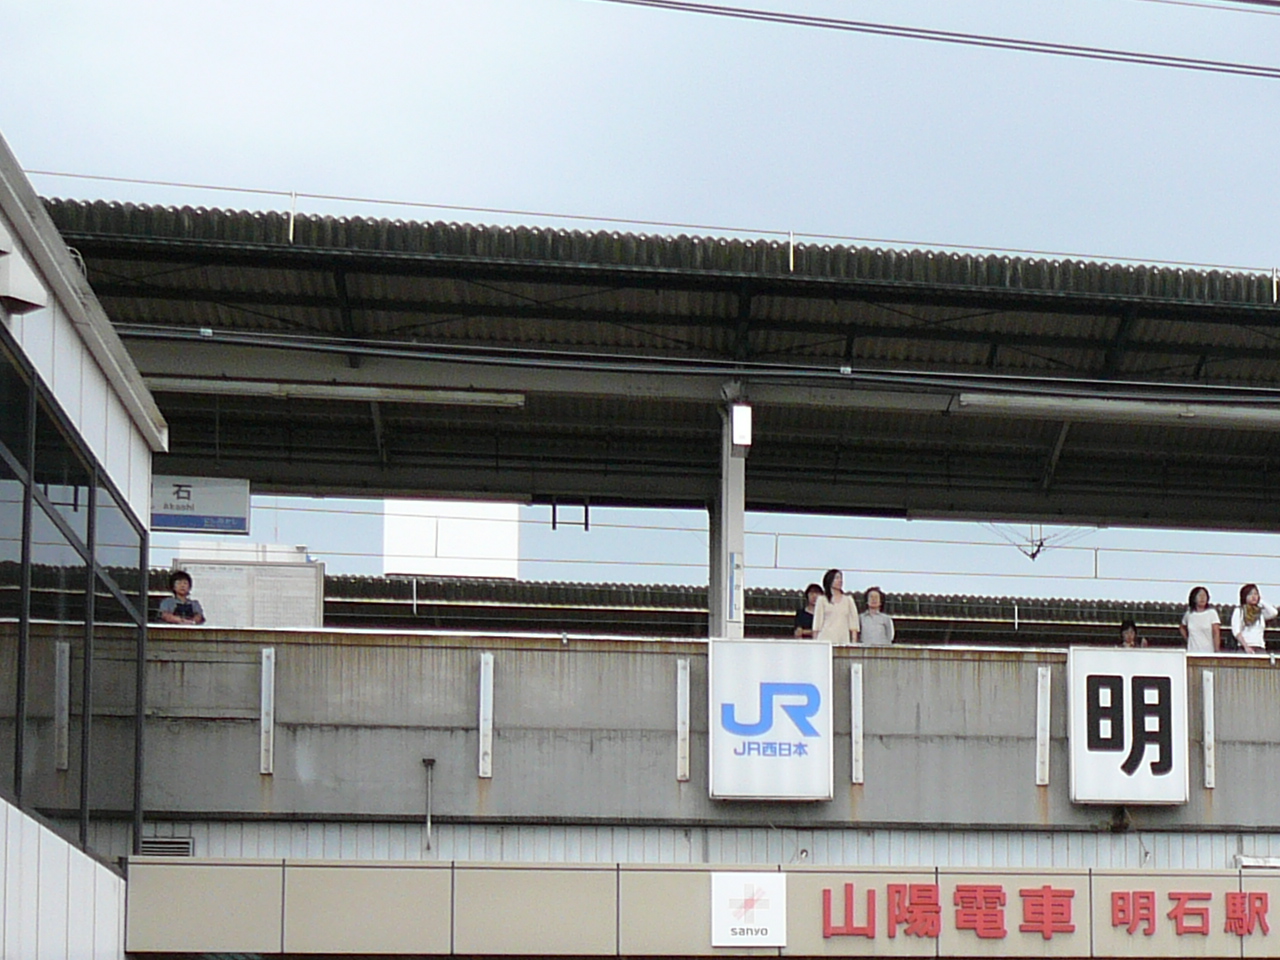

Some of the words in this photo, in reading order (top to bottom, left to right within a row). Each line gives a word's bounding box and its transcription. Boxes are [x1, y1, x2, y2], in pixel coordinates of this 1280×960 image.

[163, 502, 195, 511] Akashi
[721, 682, 822, 737] JR
[1085, 675, 1172, 776] 明
[733, 741, 809, 758] JR西日本
[822, 883, 1076, 940] 山陽電車
[1110, 891, 1270, 936] 明石駅
[730, 927, 769, 947] sanyo
